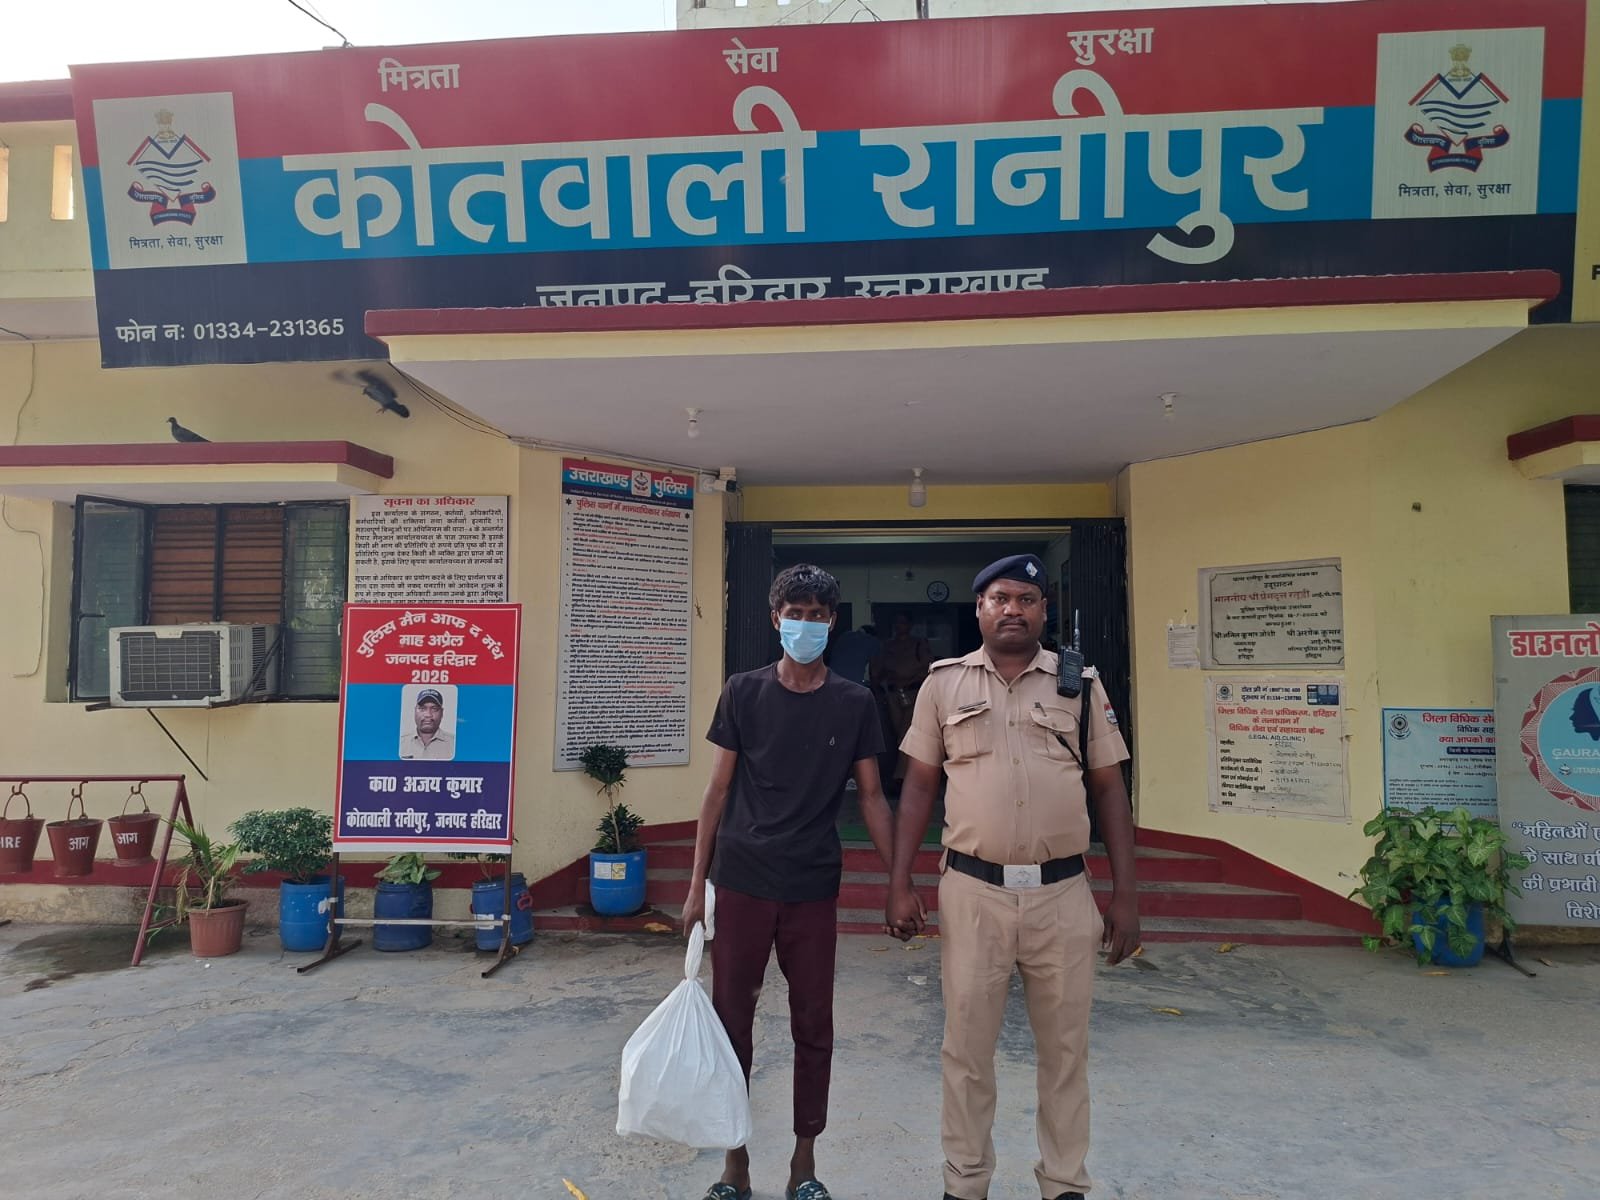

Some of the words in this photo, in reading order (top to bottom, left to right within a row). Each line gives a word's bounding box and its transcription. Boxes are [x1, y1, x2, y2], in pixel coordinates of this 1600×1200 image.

[378, 58, 460, 92] मित्रता
[723, 38, 779, 74] सेवा
[1067, 27, 1154, 66] सुरक्षा
[282, 85, 817, 249] कोतवाली
[860, 69, 1324, 265] रानीपुर
[1444, 181, 1472, 197] सेवा,
[1477, 183, 1512, 199] सुरक्षा
[167, 233, 191, 248] सेवा,
[194, 234, 224, 250] सुरक्षा
[116, 319, 156, 344] फोन
[193, 317, 345, 341] 01334-231365
[569, 467, 630, 488] उत्तराखण्ड
[654, 476, 688, 497] पुलिस
[384, 498, 413, 508] सूचना
[416, 498, 430, 506] का
[435, 496, 475, 506] अधिकार
[576, 498, 596, 511] पुलिस
[356, 620, 397, 658] पुलिस
[399, 611, 426, 627] मैन
[431, 613, 468, 629] आफ
[468, 624, 483, 638] द
[481, 634, 504, 660] मंथ
[399, 634, 425, 647] माह
[428, 630, 465, 648] अप्रैल
[385, 653, 430, 665] जनपद
[433, 650, 478, 667] हरिद्वार
[411, 669, 449, 683] 2026
[1423, 712, 1447, 724] जिला
[1450, 712, 1480, 724] विधिक
[1456, 734, 1483, 744] आपको
[1482, 726, 1495, 735] सह
[403, 776, 442, 793] अजय
[445, 776, 484, 798] कुमार
[346, 807, 392, 828] कोतवाली
[435, 812, 468, 829] जनपद
[470, 809, 503, 830] हरिद्वार
[0, 836, 22, 849] IRE
[69, 836, 90, 851] आग
[115, 832, 138, 845] आग
[1521, 847, 1538, 864] के
[1542, 851, 1579, 865] साथ
[1521, 873, 1544, 890] की
[1548, 873, 1598, 893] प्रभावी
[1566, 900, 1600, 920] विशे
